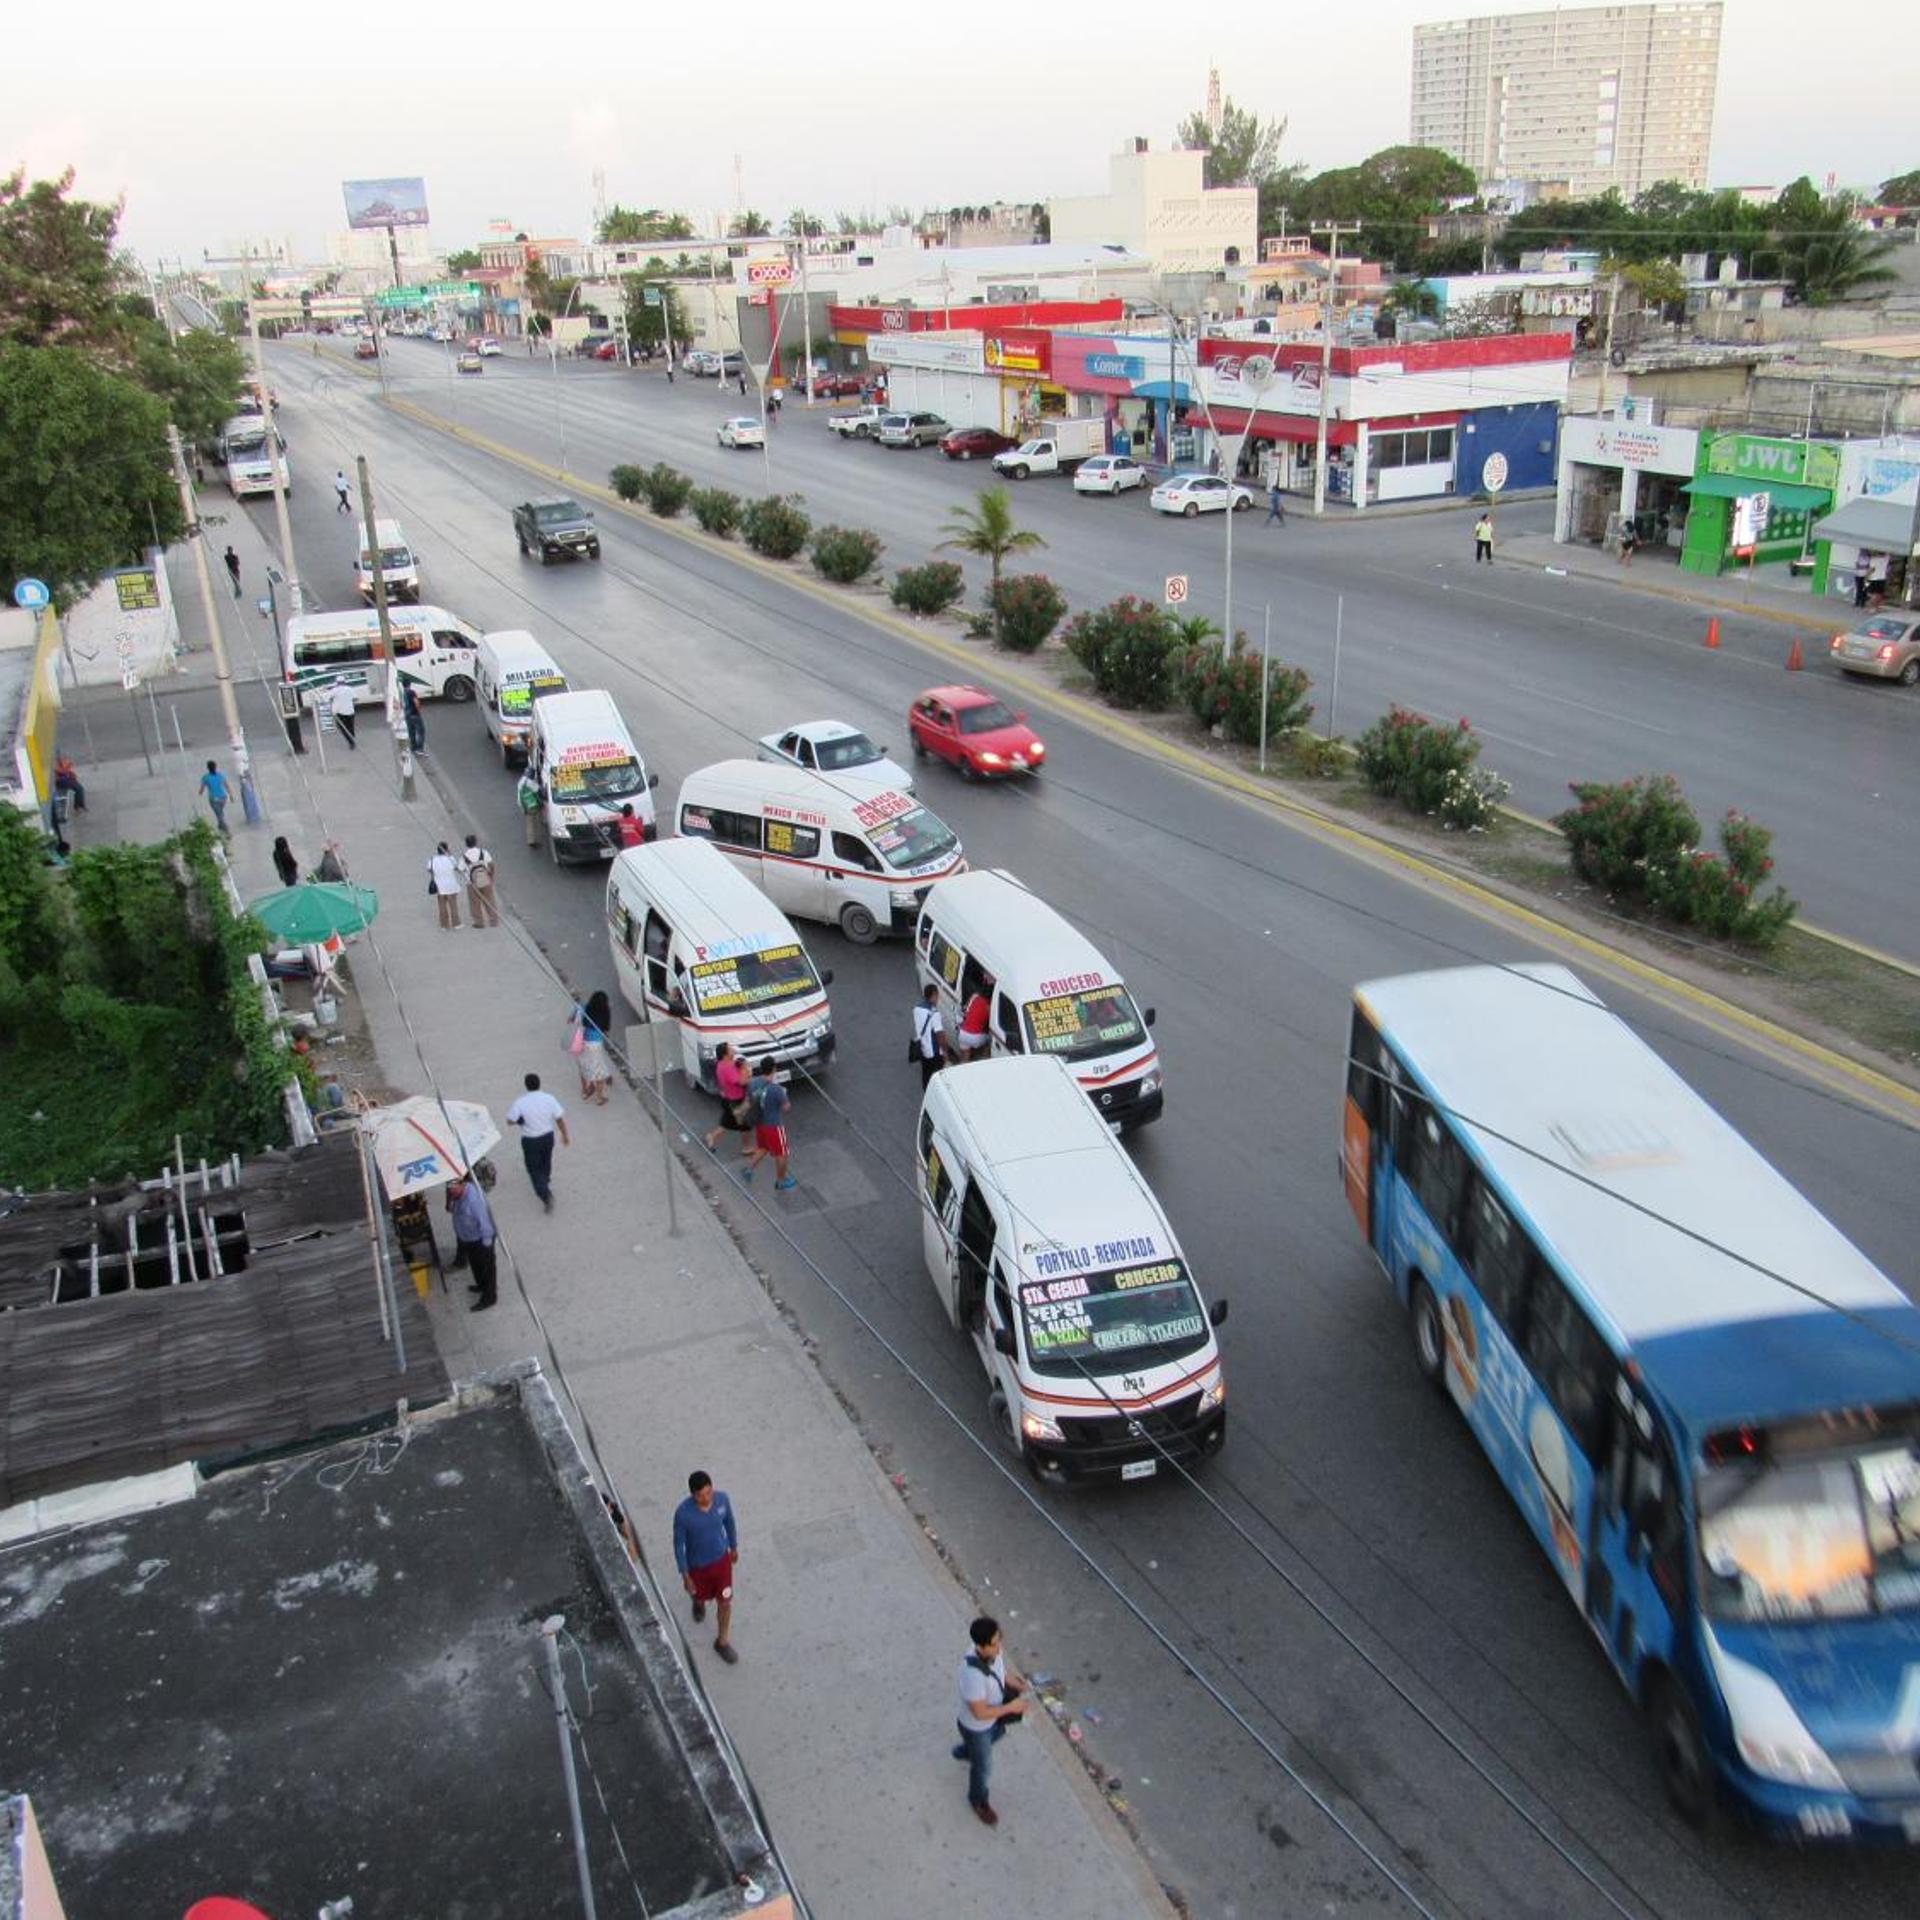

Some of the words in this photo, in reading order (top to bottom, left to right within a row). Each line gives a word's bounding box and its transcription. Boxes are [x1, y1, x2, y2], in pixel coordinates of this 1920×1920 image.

[751, 265, 791, 282] OXXO
[506, 669, 554, 682] MILAGRO
[763, 805, 792, 818] MEXICO
[853, 791, 897, 814] MEXICO
[860, 797, 911, 827] CRUCERO
[1040, 972, 1103, 997] CRUCERO
[1048, 1277, 1090, 1301] CECILIA
[1114, 1264, 1179, 1290] CRUCERO
[1027, 1299, 1084, 1324] PEPSI
